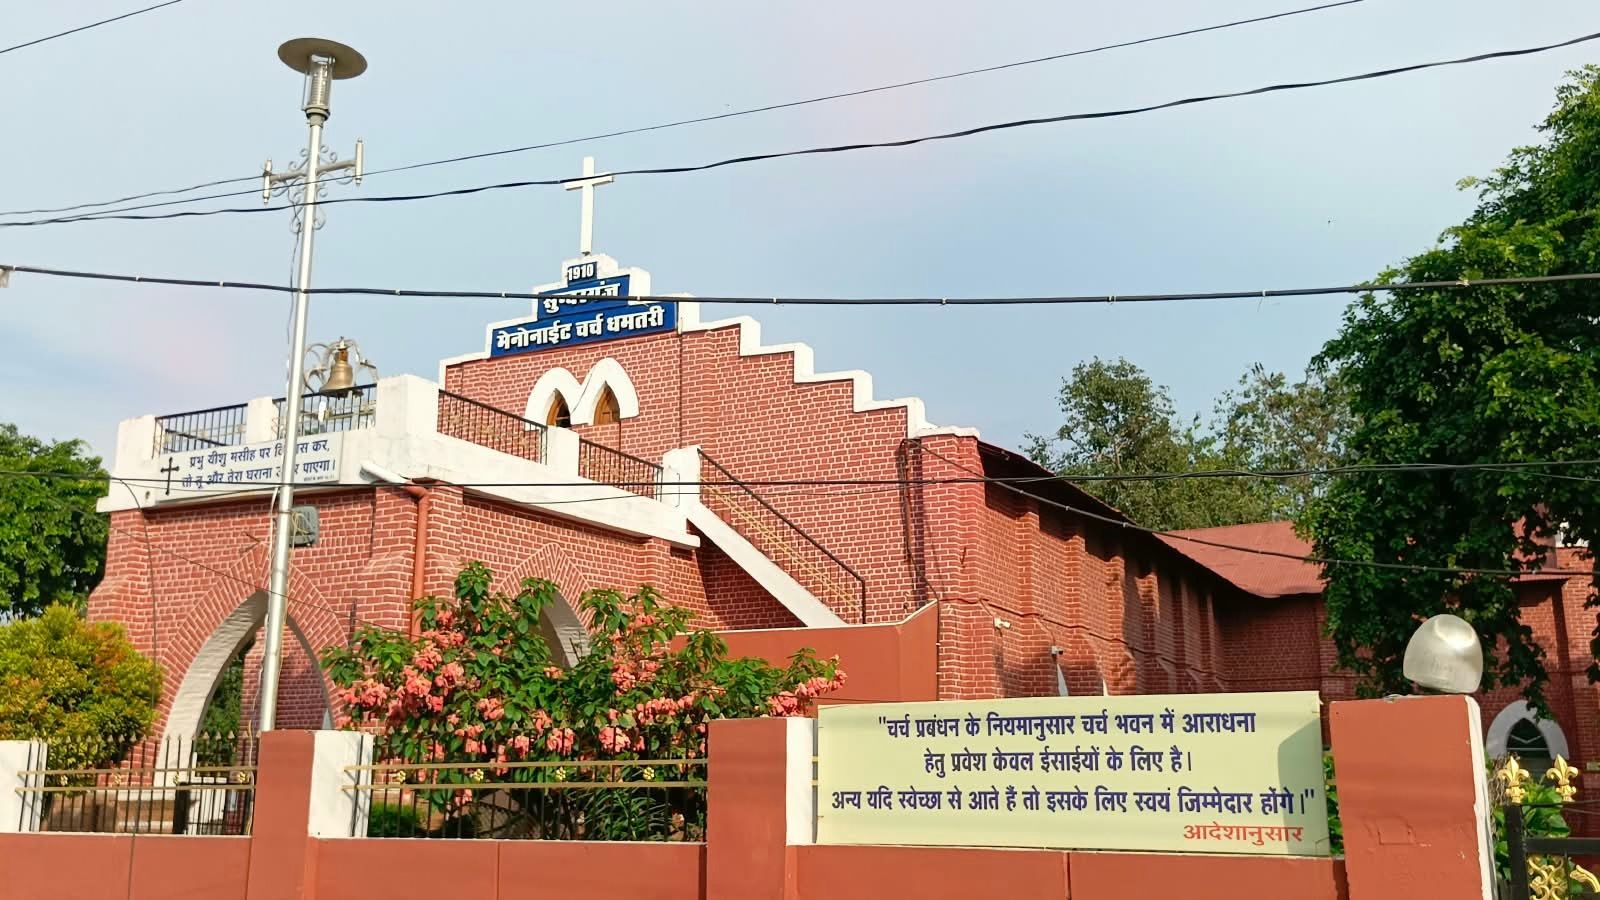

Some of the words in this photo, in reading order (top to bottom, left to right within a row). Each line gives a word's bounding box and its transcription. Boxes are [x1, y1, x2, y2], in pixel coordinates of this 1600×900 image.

[567, 263, 594, 280] 1910
[496, 320, 573, 350] मेनोनाईट
[575, 313, 604, 338] चर्च
[606, 305, 665, 332] धमतरी
[189, 456, 205, 470] प्रभु
[207, 452, 227, 467] यीशु
[230, 447, 256, 463] मसीह
[259, 447, 272, 459] पर
[181, 474, 193, 488] तो
[206, 471, 224, 485] और
[227, 468, 243, 483] तेरा
[245, 466, 272, 481] घराना
[915, 714, 960, 738] प्रबंधन
[965, 711, 981, 737] के
[986, 711, 1076, 742] नियमानुसार
[1081, 708, 1108, 735] चर्च
[1114, 711, 1154, 734] भवन
[1160, 707, 1175, 734] में
[1182, 711, 1256, 734] आराधना
[923, 748, 946, 778] हेतु
[950, 746, 987, 773] प्रवेश
[992, 747, 1034, 772] केवल
[1039, 745, 1100, 773] ईसाईयों
[1105, 745, 1124, 772] के
[1130, 744, 1163, 773] लिए
[831, 790, 862, 810] अन्य
[867, 785, 893, 810] यदि
[898, 785, 942, 810] स्वेच्छा
[946, 785, 962, 810] से
[968, 785, 1000, 811] आते
[1005, 785, 1017, 812] हैं
[1022, 785, 1041, 811] तो
[1045, 785, 1089, 812] इसके
[1094, 785, 1128, 813] लिए
[1133, 787, 1171, 813] स्वयं
[1177, 785, 1253, 814] जिम्मेदार
[1183, 821, 1304, 846] आदेशानुसार
